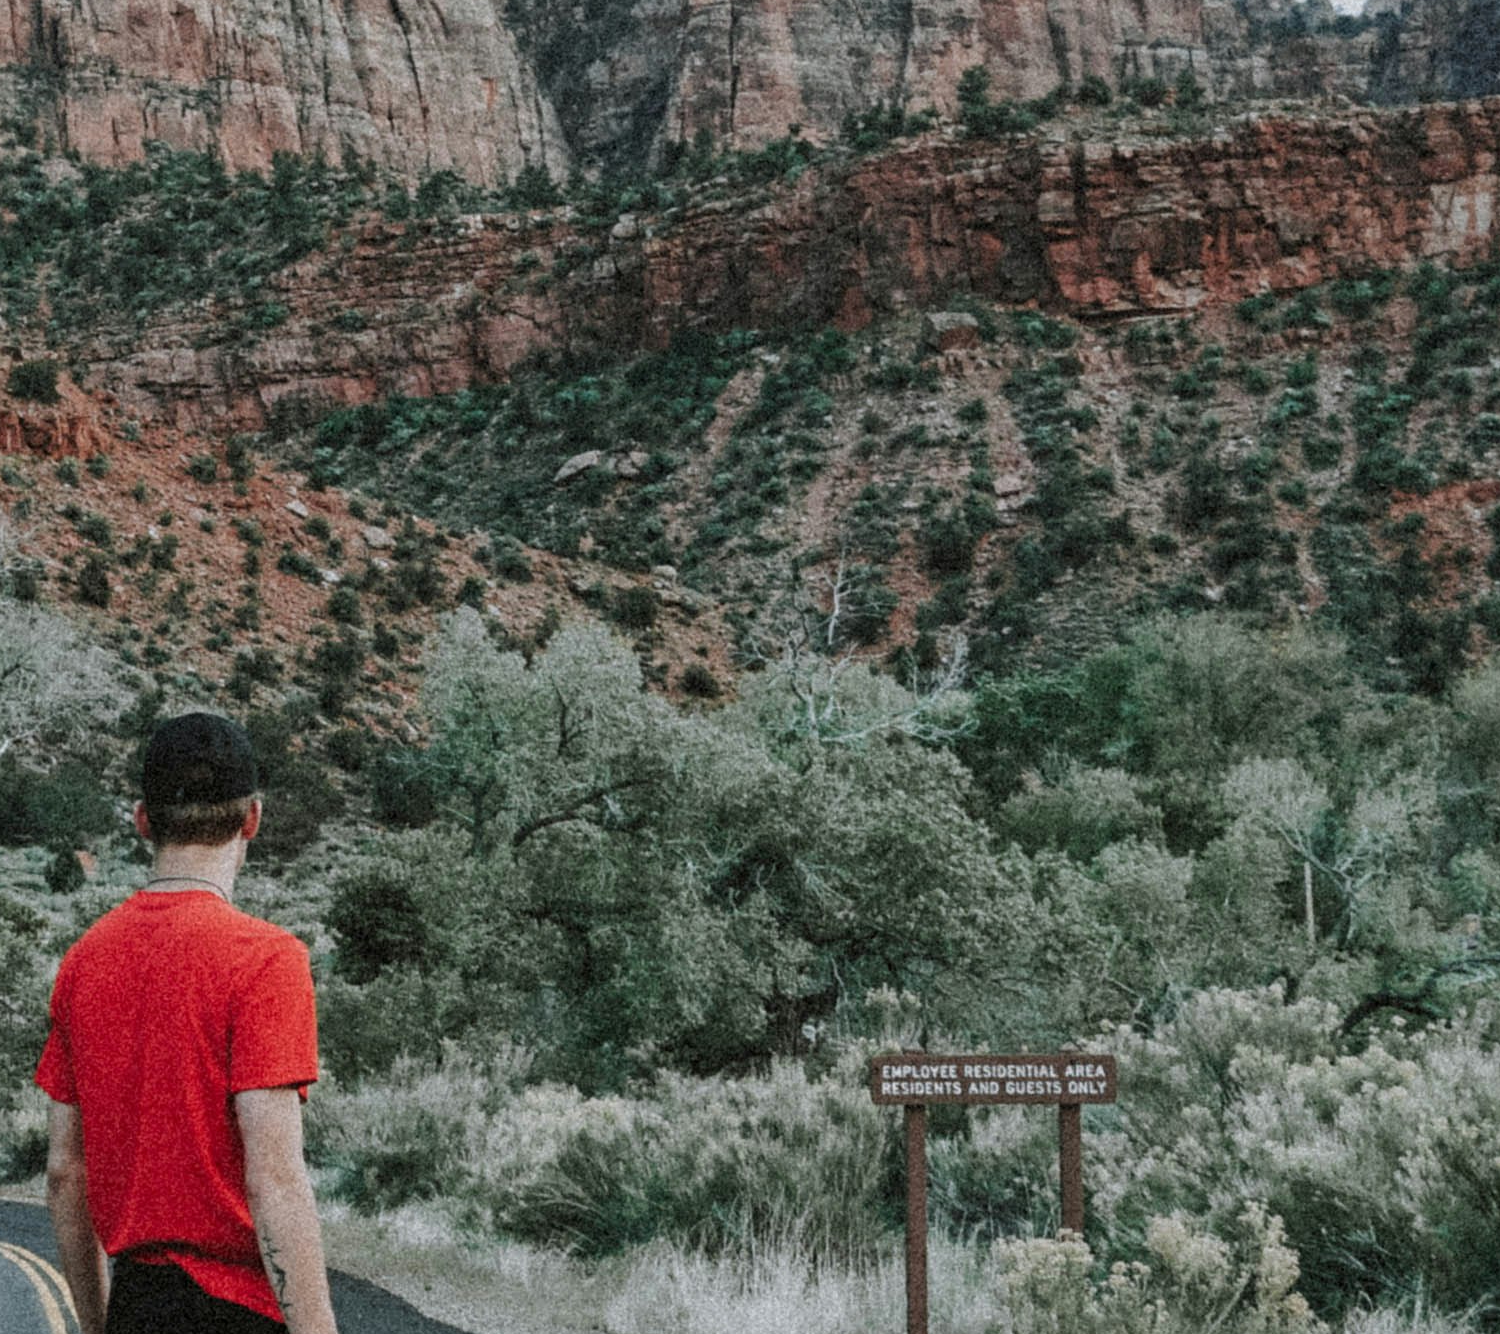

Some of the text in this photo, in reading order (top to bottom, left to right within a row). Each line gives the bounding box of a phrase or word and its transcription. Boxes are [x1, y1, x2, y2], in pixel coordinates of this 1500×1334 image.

[882, 1064, 1105, 1079] EMPLOYEE RESIDENTIAL AREA
[881, 1080, 1108, 1095] RESIDENTS AND GUESTS ONLY
